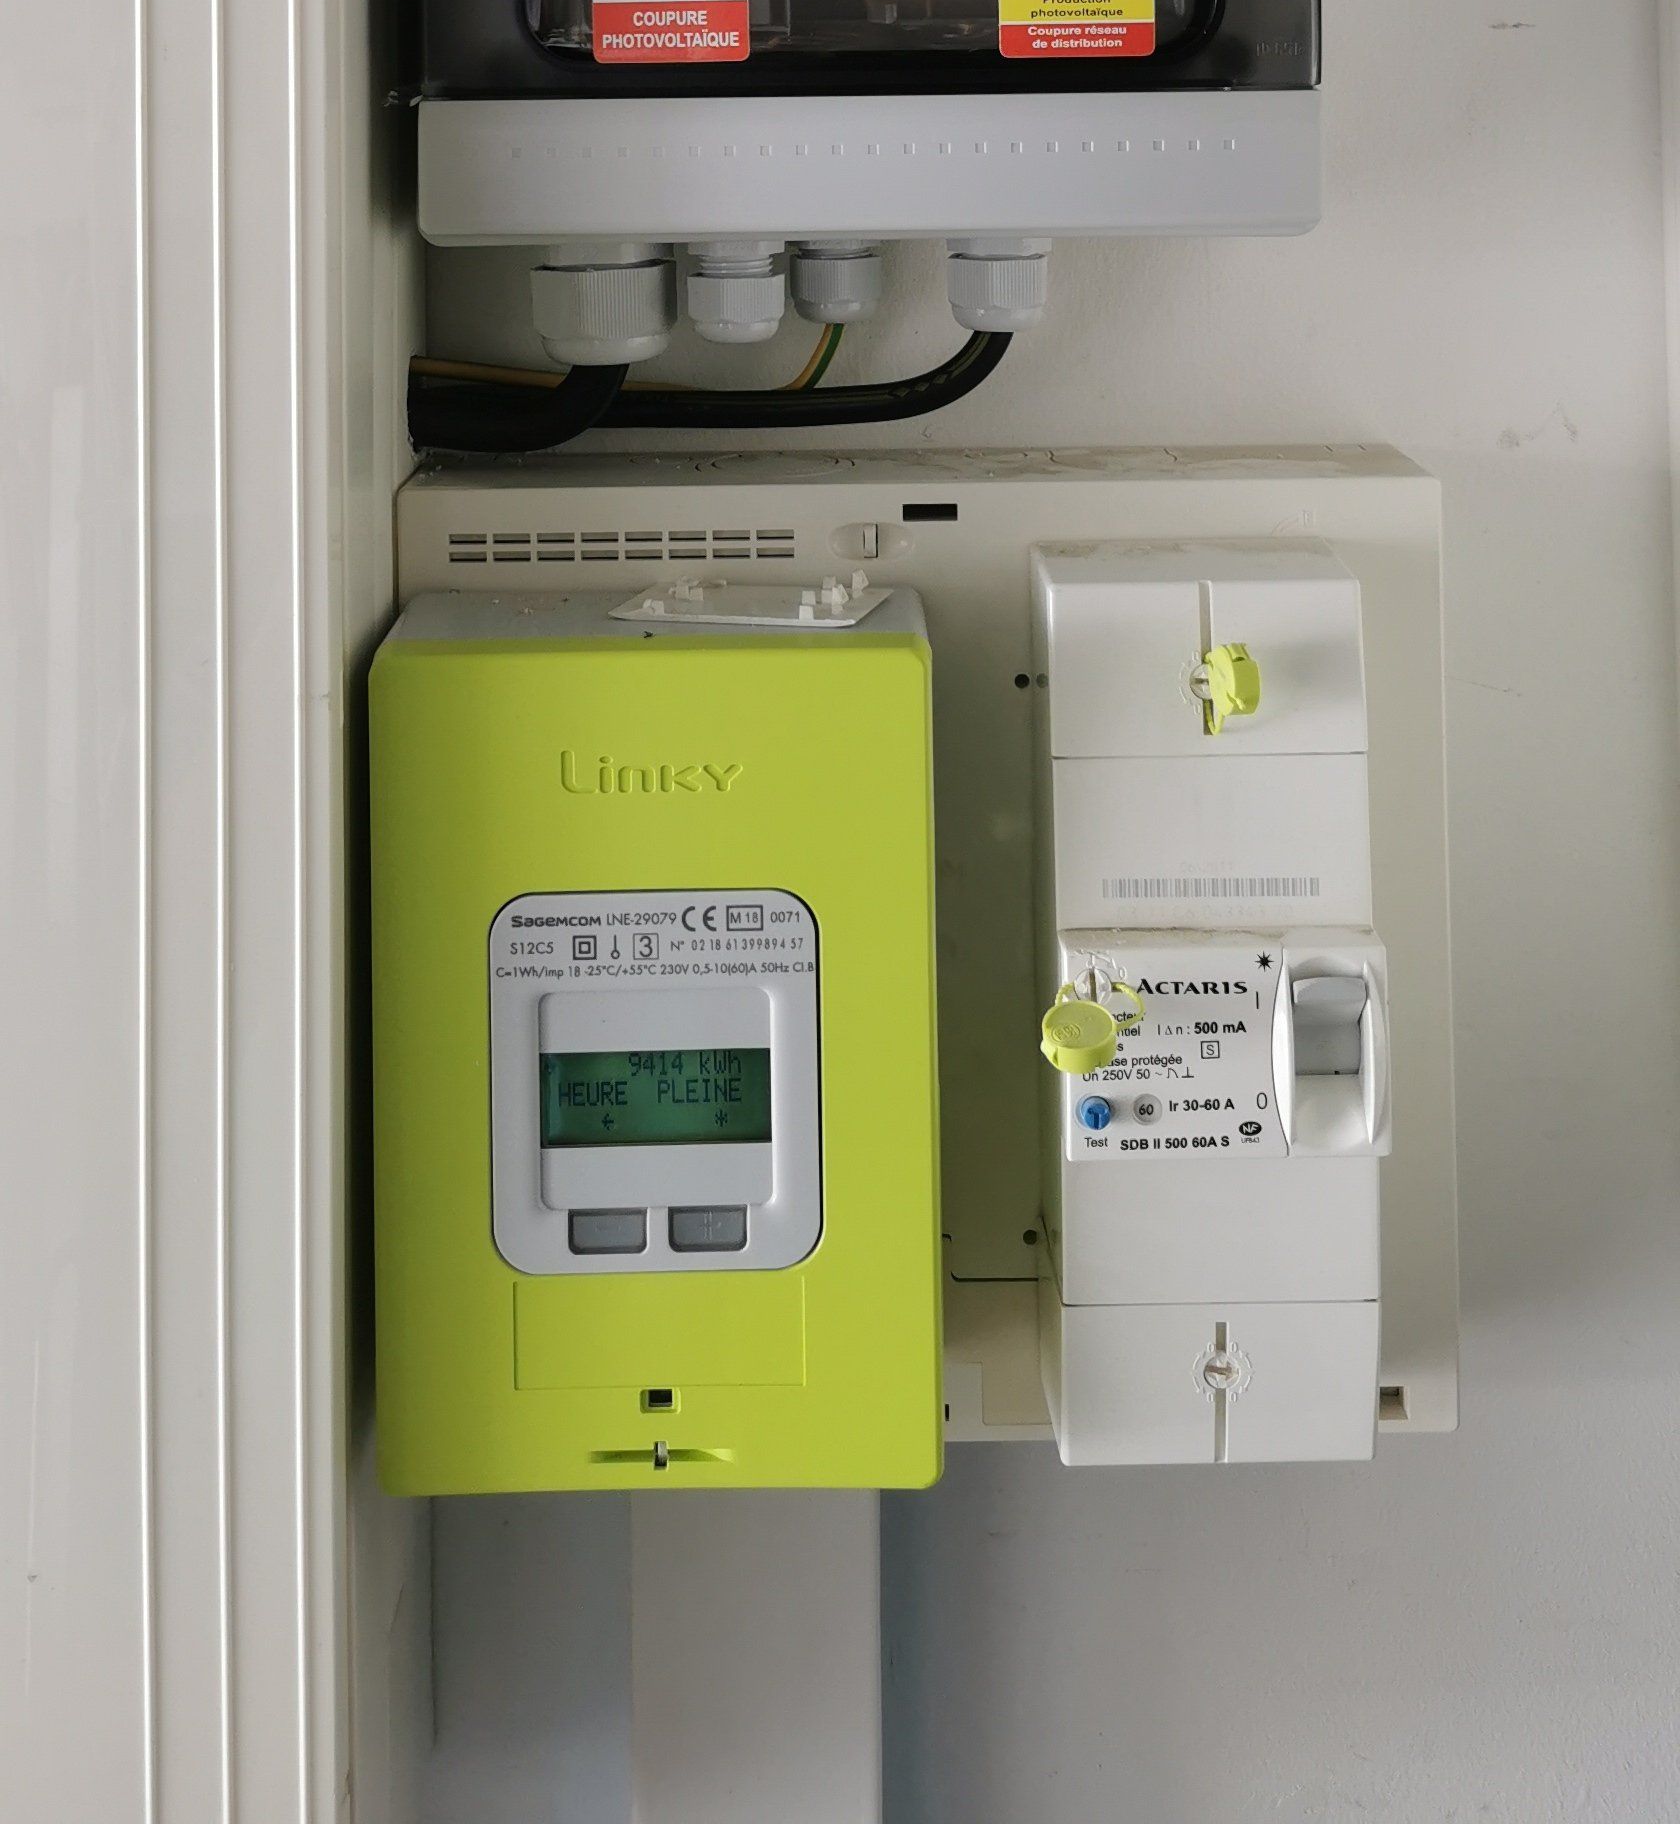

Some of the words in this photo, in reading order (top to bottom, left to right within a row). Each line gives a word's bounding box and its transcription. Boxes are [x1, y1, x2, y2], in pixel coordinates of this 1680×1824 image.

[633, 10, 707, 26] COUPURE
[1030, 7, 1123, 19] photovoltaïque
[1028, 26, 1082, 38] Coupure
[1084, 25, 1127, 36] réseau
[602, 29, 740, 49] PHOTOVOLTAÏQUE
[1032, 39, 1048, 49] de
[1051, 38, 1123, 49] distribution
[606, 912, 677, 925] LNE-29079
[770, 911, 801, 923] 0071
[510, 941, 554, 955] S12C5
[637, 935, 654, 957] 3
[691, 939, 705, 951] 02
[710, 939, 721, 950] 18
[660, 963, 689, 975] 230V
[760, 962, 789, 973] 50Hz
[1137, 978, 1248, 995] ACTARIS
[1194, 1022, 1219, 1035] 500
[1223, 1021, 1247, 1033] mA
[628, 1051, 683, 1077] 9414
[699, 1050, 742, 1074] kWh
[1132, 1056, 1183, 1068] protégée
[1102, 1069, 1132, 1081] 250V
[1136, 1069, 1150, 1080] 50
[558, 1081, 628, 1107] HEURE
[657, 1078, 742, 1103] PLEINE
[1138, 1104, 1154, 1115] 60
[1183, 1099, 1221, 1111] 30-60
[1225, 1099, 1235, 1110] A
[1085, 1137, 1108, 1147] Test
[1120, 1139, 1149, 1150] SDB
[1165, 1138, 1188, 1149] 500
[1192, 1137, 1217, 1148] 60A
[1220, 1136, 1230, 1147] S
